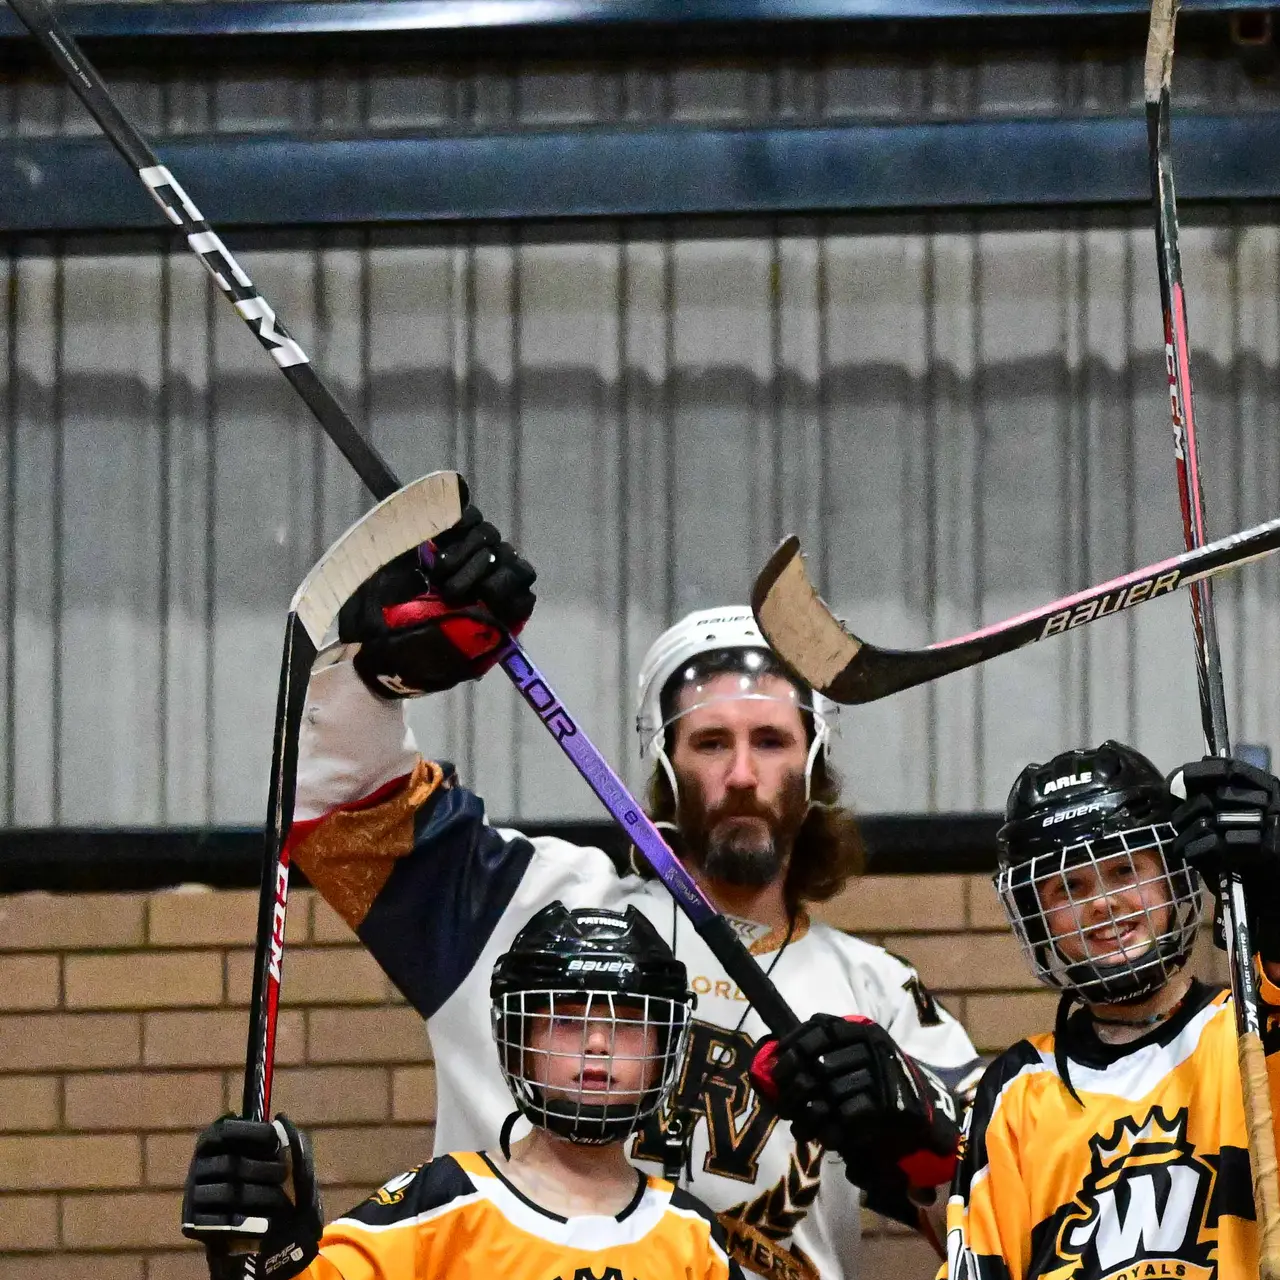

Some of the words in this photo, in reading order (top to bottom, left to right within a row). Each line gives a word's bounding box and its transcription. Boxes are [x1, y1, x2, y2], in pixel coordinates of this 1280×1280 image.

[138, 165, 310, 368] CCM
[1039, 570, 1181, 641] BAUER
[501, 651, 577, 743] COR
[1042, 803, 1101, 828] BAUER
[1043, 771, 1092, 796] ARLE
[268, 861, 290, 984] CCM
[577, 916, 629, 930] PATRICK
[568, 959, 636, 973] BAUER
[1069, 1164, 1201, 1272] W
